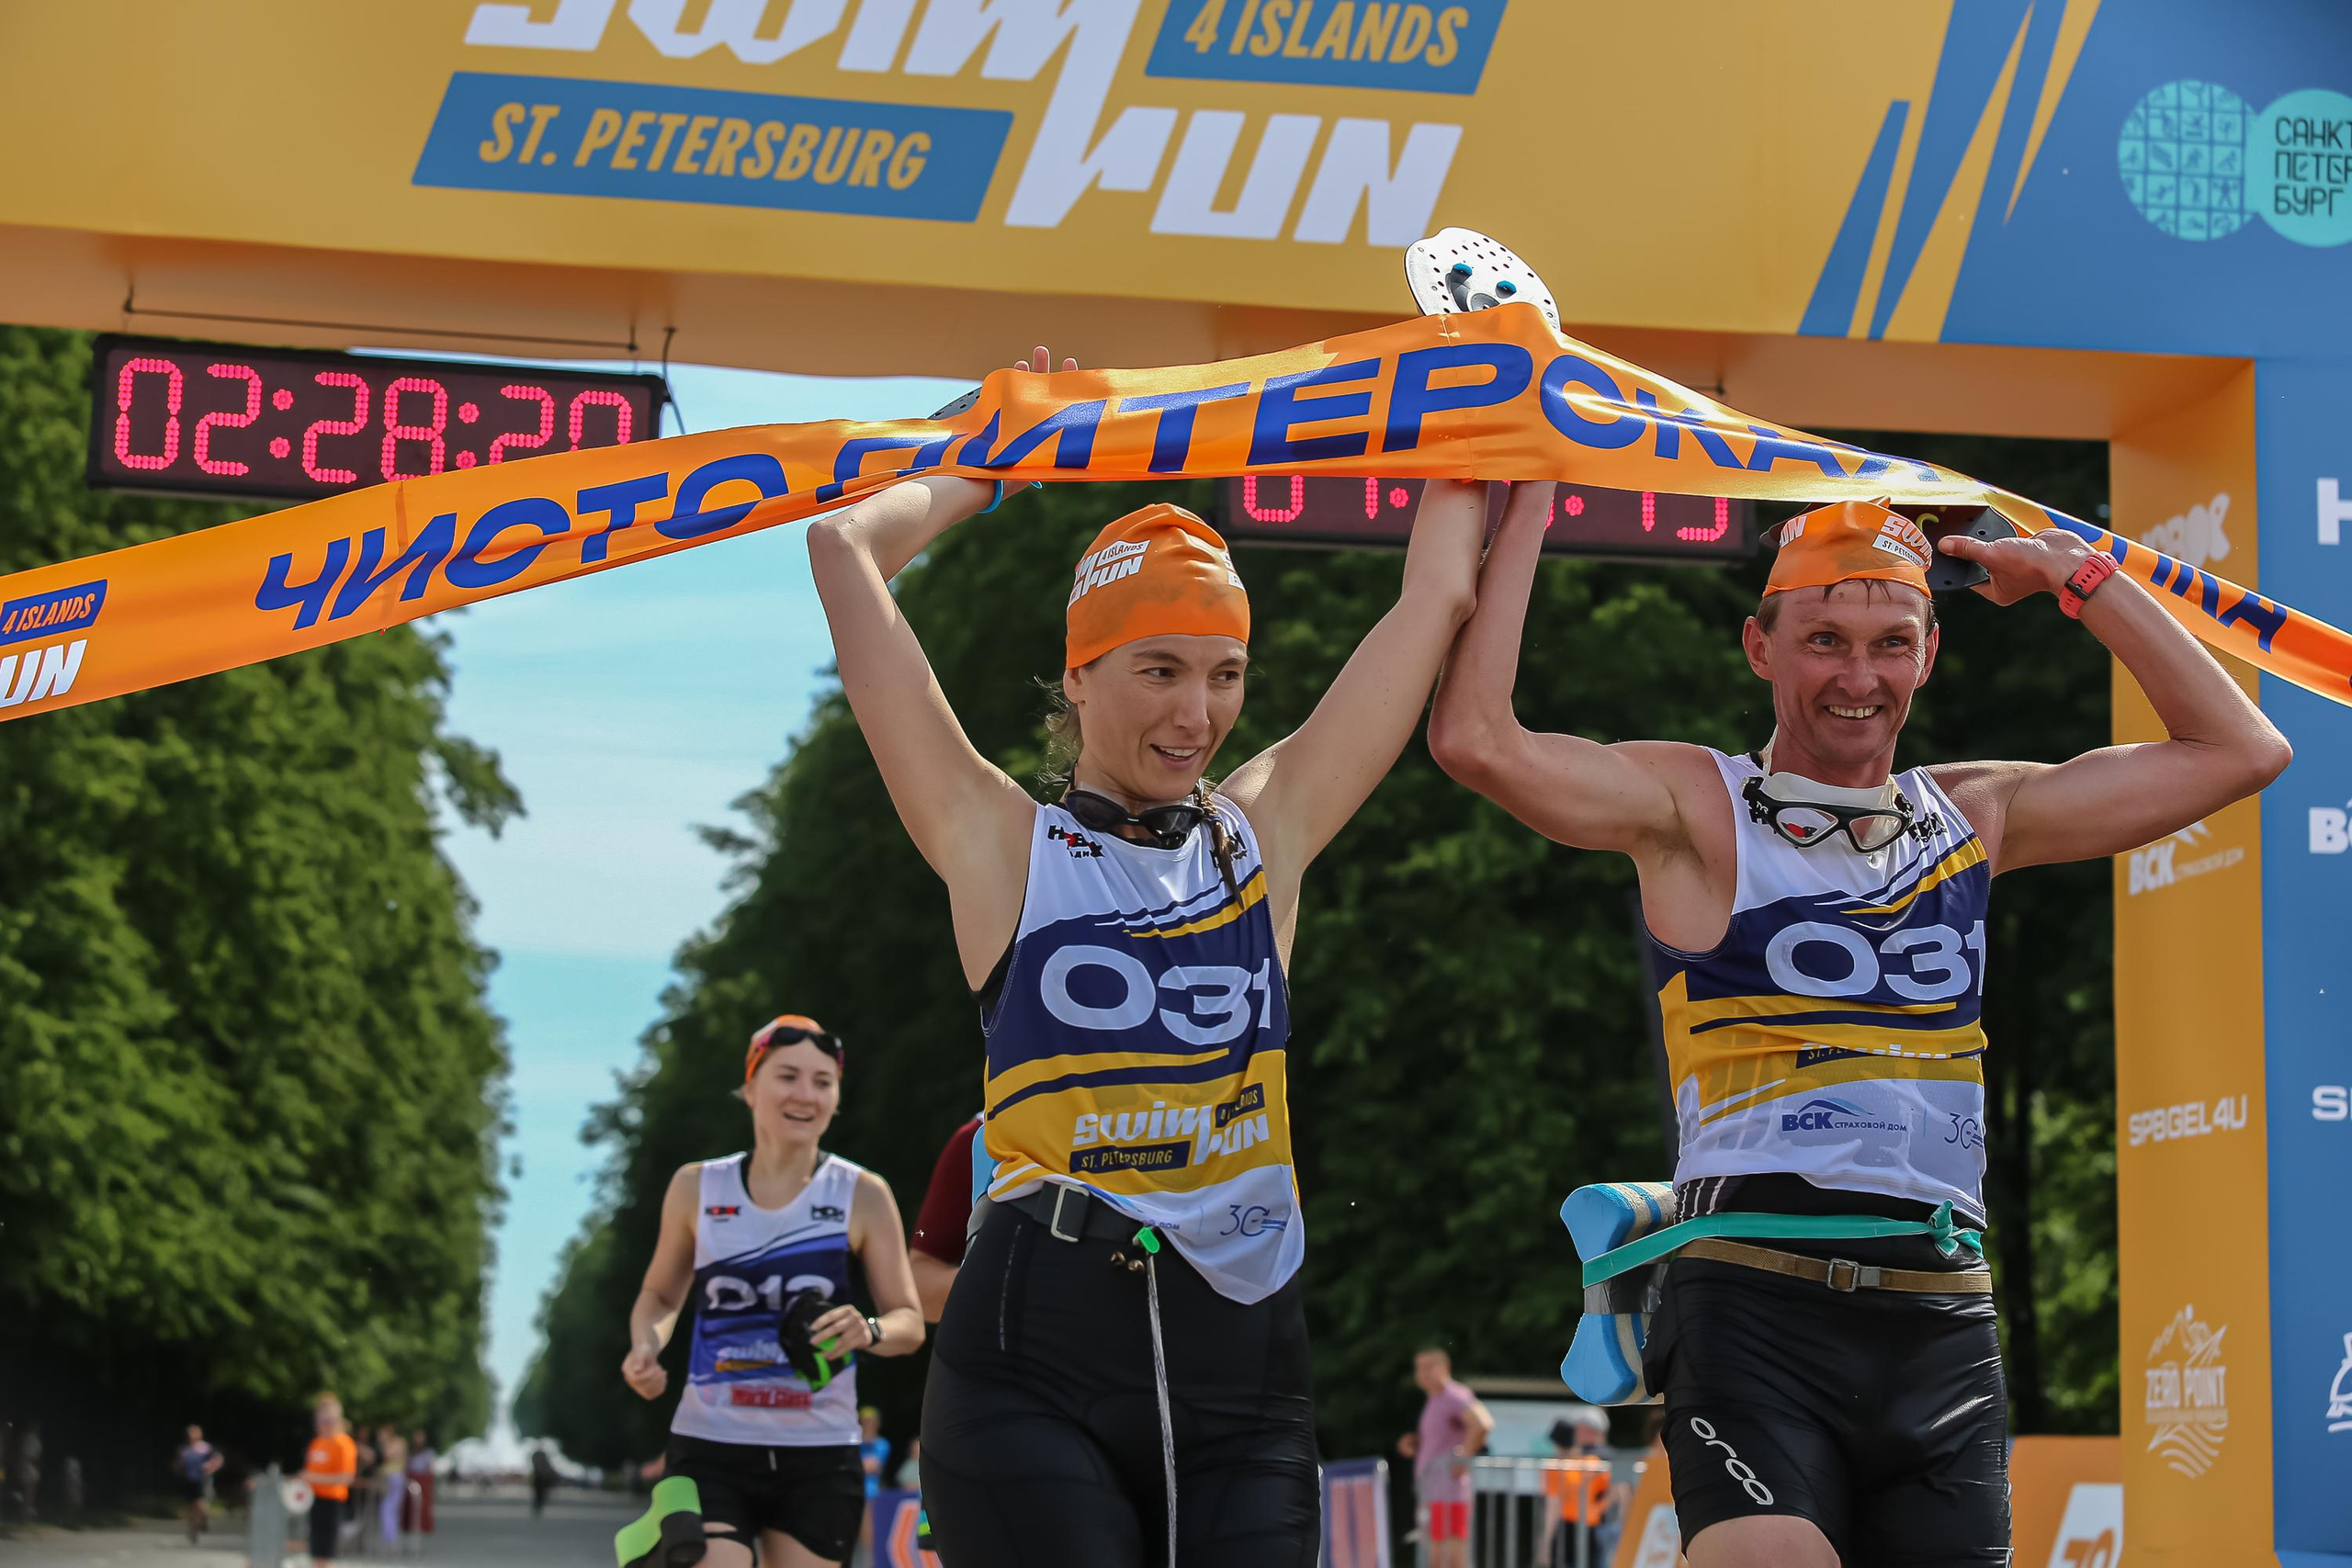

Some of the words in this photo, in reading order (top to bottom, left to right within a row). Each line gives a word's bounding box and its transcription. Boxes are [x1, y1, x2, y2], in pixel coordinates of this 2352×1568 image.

[1183, 0, 1227, 53] 4
[1228, 0, 1470, 67] ISLANDS
[479, 102, 560, 166] ST.
[573, 107, 932, 190] PETERSBURG
[2274, 184, 2345, 218] БУРГ
[254, 453, 790, 631] ЧИСТО
[1107, 543, 1144, 559] ISLANDS
[2, 610, 18, 635] 4
[16, 592, 96, 633] ISLANDS
[1766, 919, 1986, 1001] 031
[1040, 944, 1271, 1045] 031
[1781, 1111, 1835, 1132] ВСК
[1834, 1120, 1885, 1130] СТРАХОВОЙ
[1887, 1122, 1907, 1132] ДОМ
[1080, 1154, 1098, 1168] ST.
[1101, 1149, 1173, 1168] PETERSBURG
